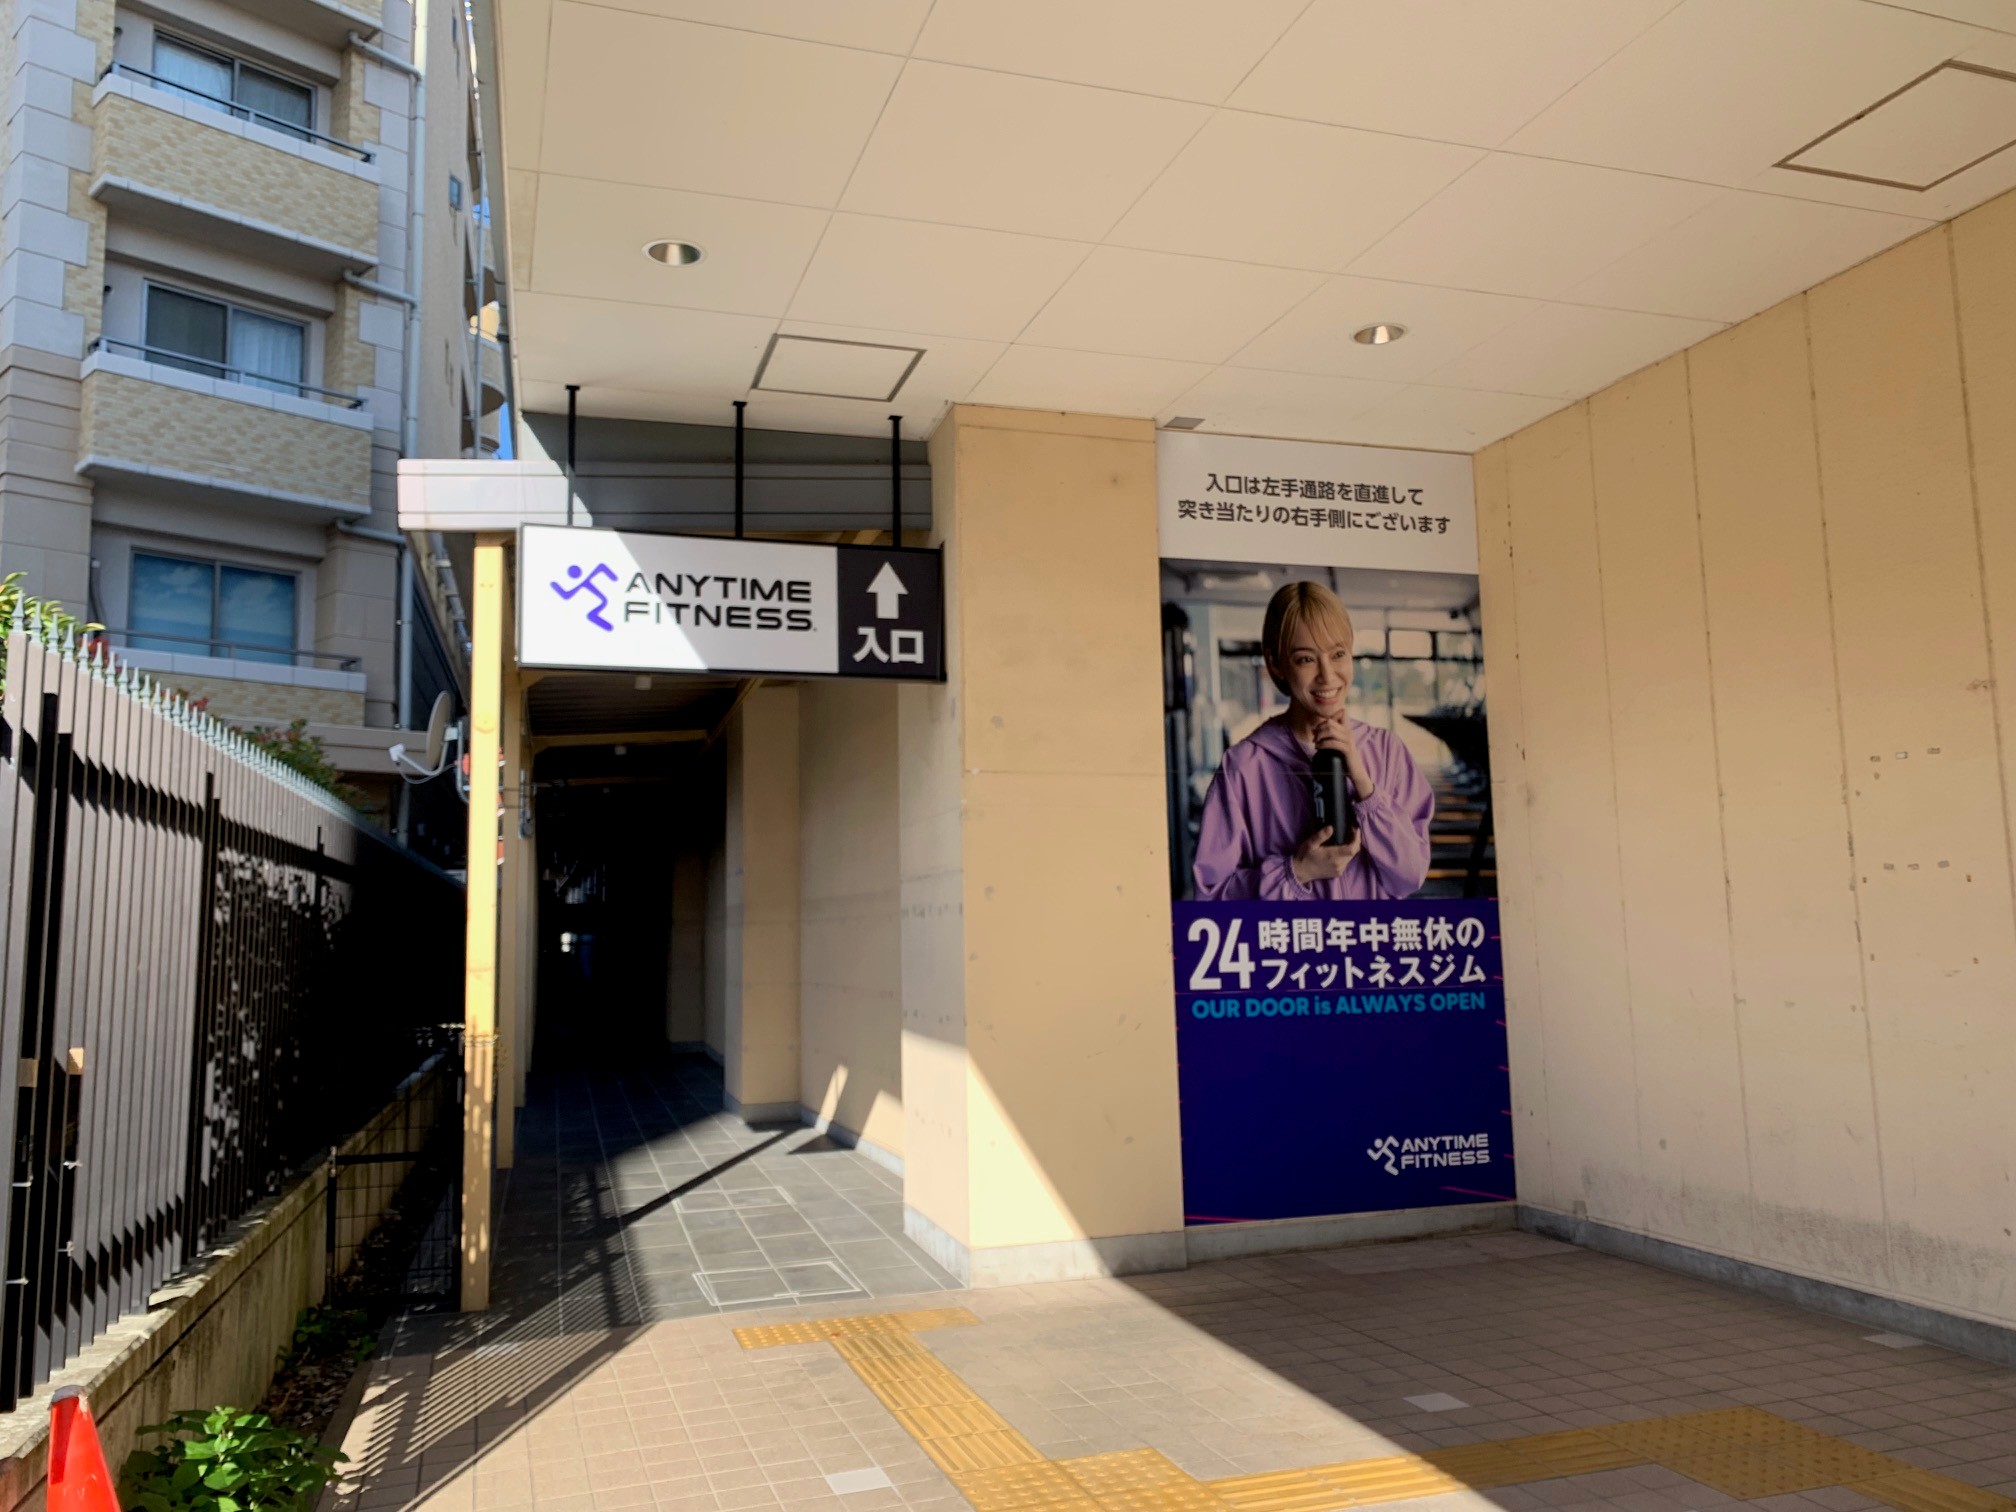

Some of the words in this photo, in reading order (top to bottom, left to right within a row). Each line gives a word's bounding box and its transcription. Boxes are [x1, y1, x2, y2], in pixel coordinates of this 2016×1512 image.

[1206, 473, 1423, 506] 入口は左手通路を直進して
[1178, 500, 1450, 534] 突き当たりの右手側にございます
[625, 572, 812, 603] ANYTIME
[624, 601, 813, 631] FITNESS
[853, 626, 924, 664] 入口
[1187, 917, 1256, 990] 24
[1257, 916, 1486, 953] 時間年中無休の
[1260, 954, 1487, 990] フィットネスジム
[1191, 998, 1241, 1019] OUR
[1245, 997, 1309, 1017] DOOR
[1314, 995, 1331, 1015] is
[1335, 993, 1426, 1014] ALWAYS
[1430, 992, 1486, 1012] OPEN
[1401, 1133, 1489, 1153] ANYTIME
[1401, 1150, 1490, 1169] FITNESS
